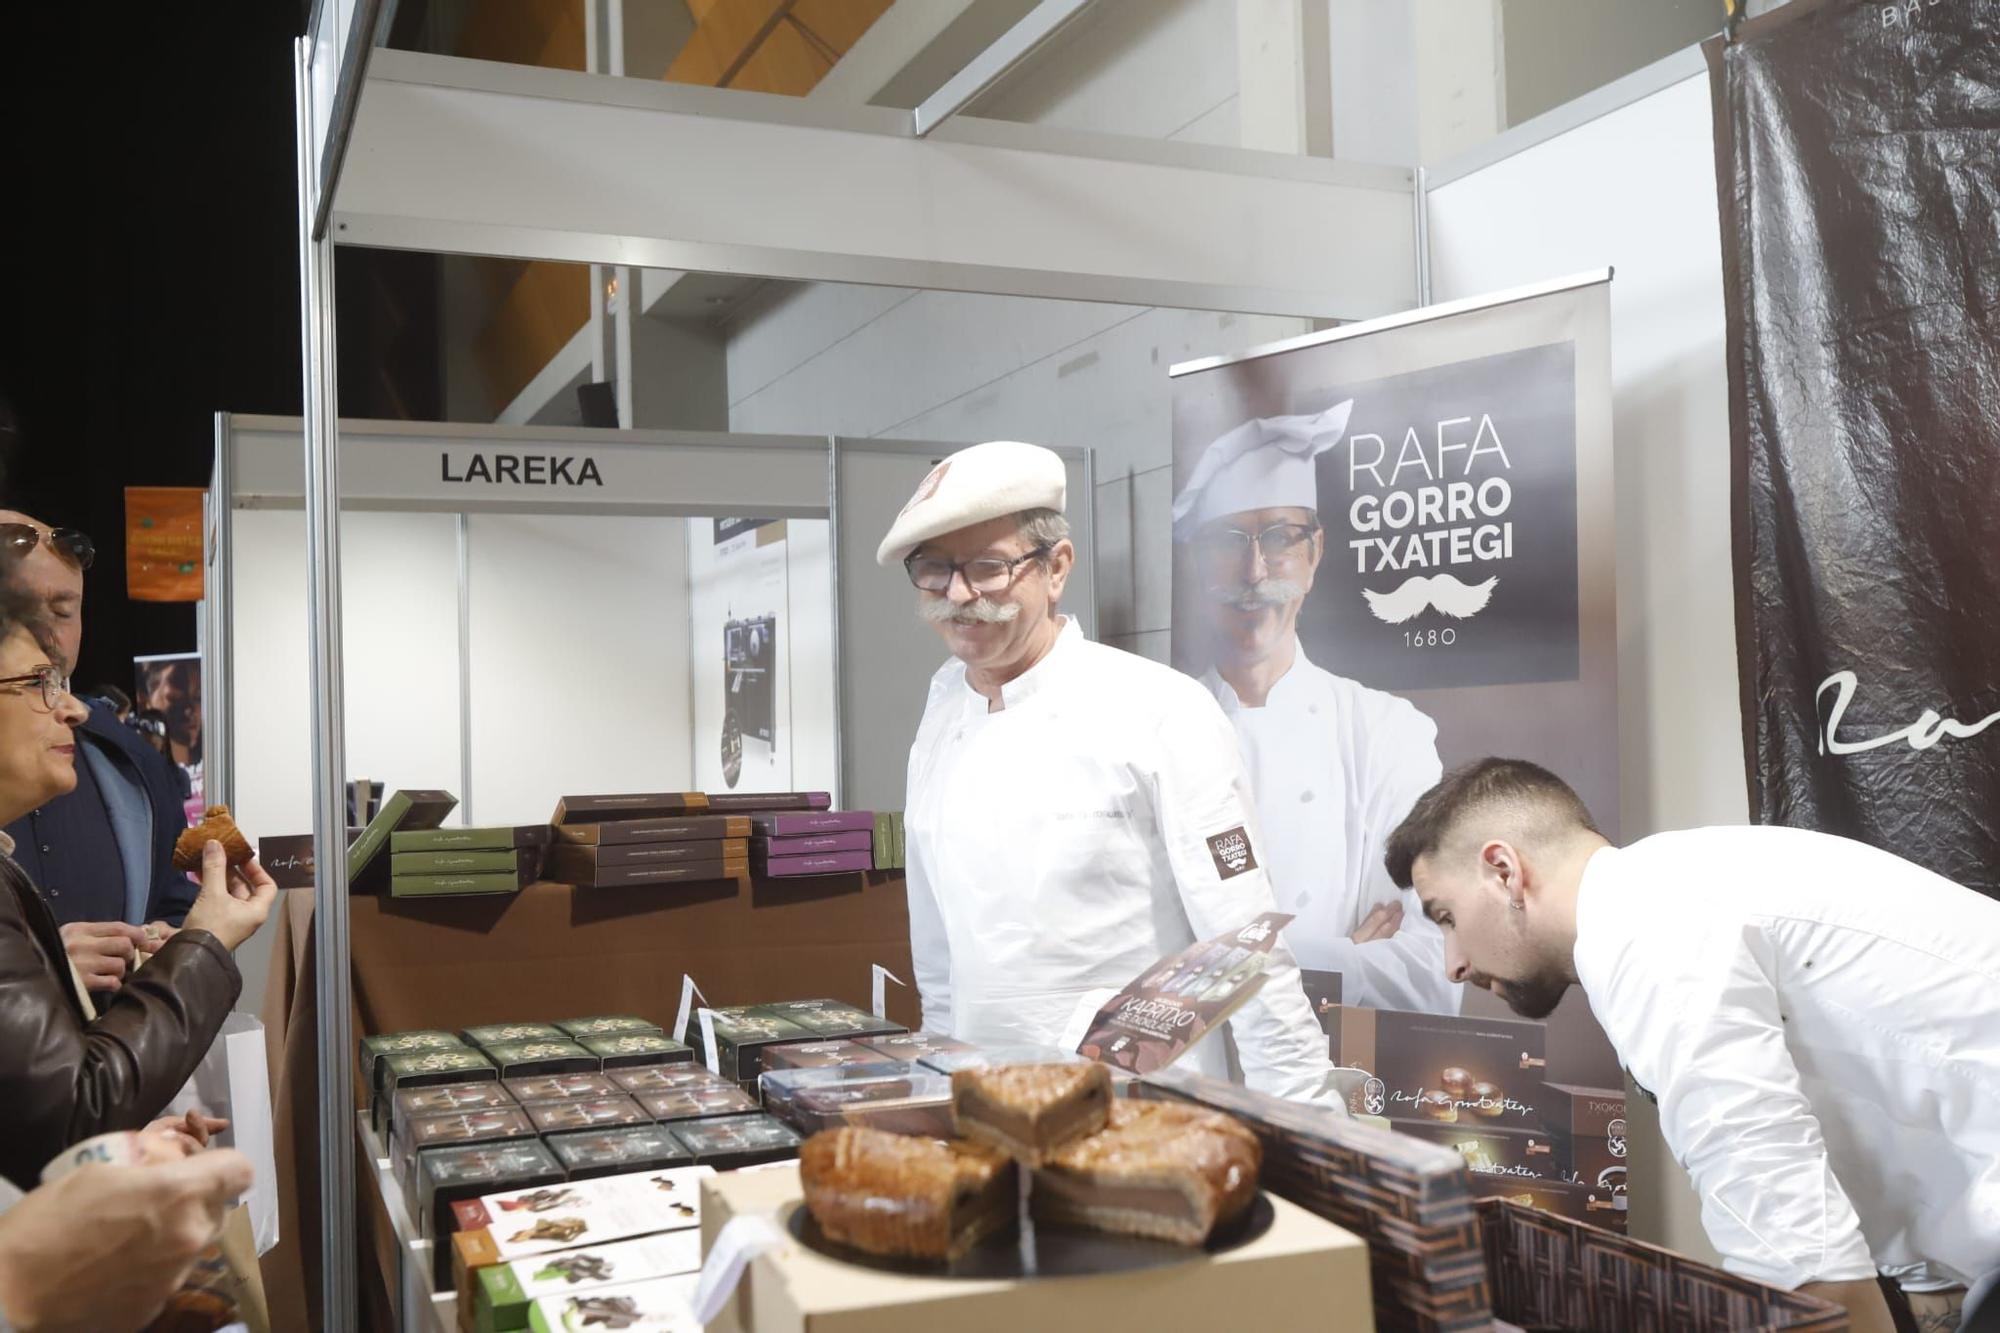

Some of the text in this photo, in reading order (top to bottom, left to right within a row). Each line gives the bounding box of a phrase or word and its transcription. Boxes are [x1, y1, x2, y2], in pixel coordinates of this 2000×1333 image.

[1349, 413, 1511, 491] RAFA
[442, 453, 603, 486] LAREKA
[1349, 476, 1512, 533] GORRO
[1349, 521, 1513, 574] TXATEGI
[1404, 627, 1456, 648] 1680
[1215, 834, 1244, 851] RAFA
[1120, 996, 1196, 1027] KAPRITXO
[1588, 1101, 1626, 1113] TXOKO
